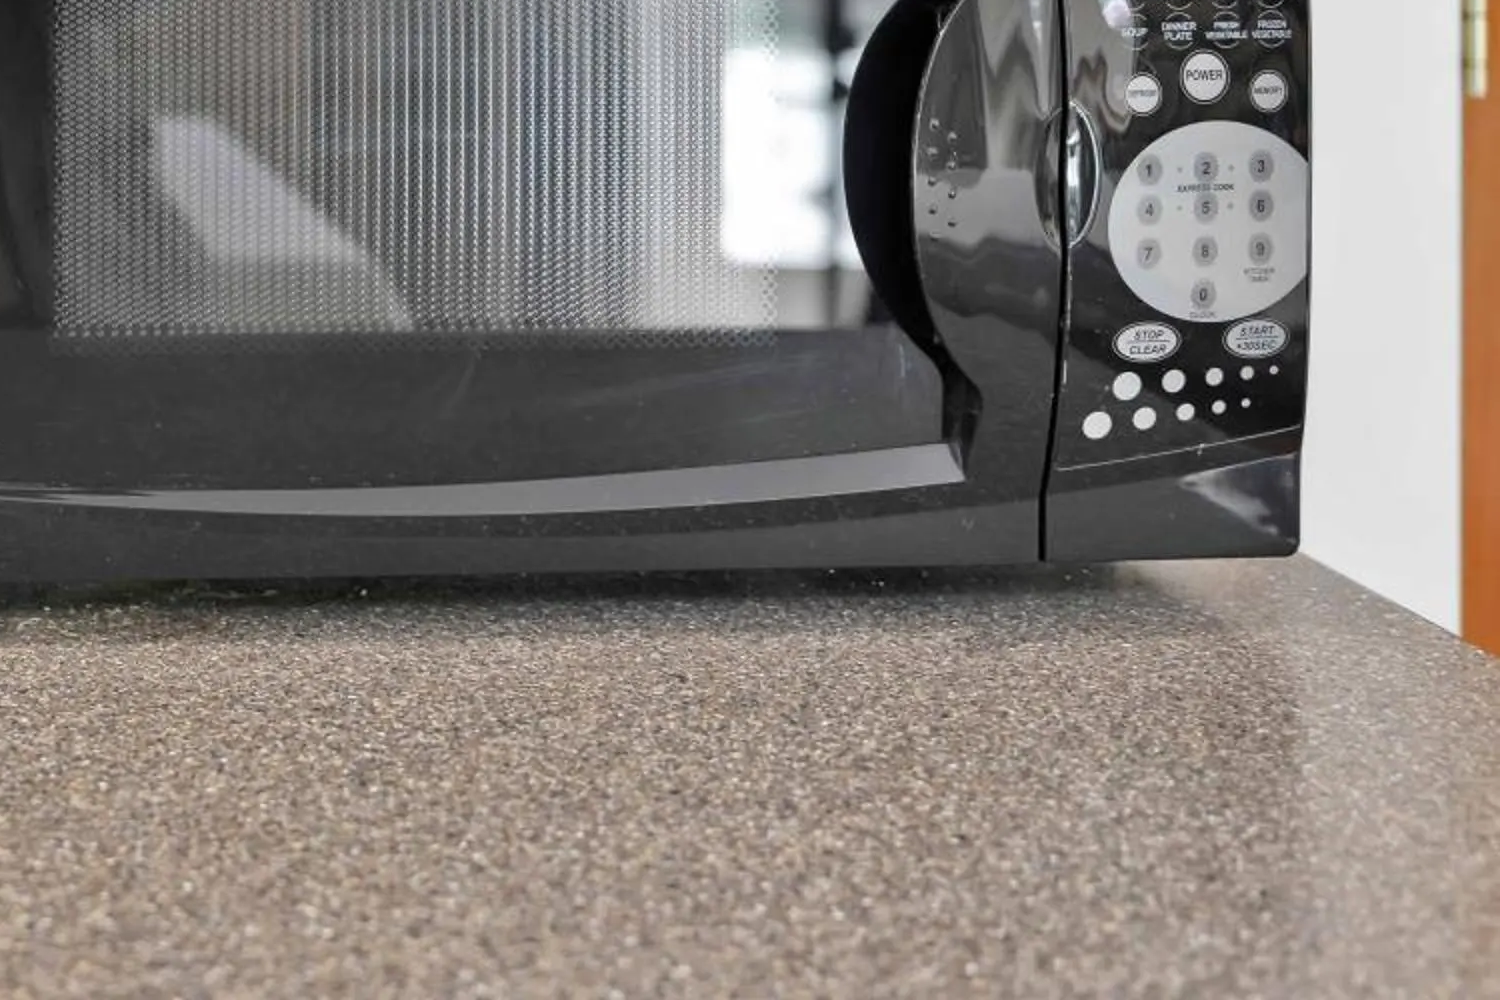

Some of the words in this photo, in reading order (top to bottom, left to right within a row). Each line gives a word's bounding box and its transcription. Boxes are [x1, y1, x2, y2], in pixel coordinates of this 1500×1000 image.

[1161, 21, 1197, 31] DINNER
[1164, 31, 1193, 41] PLATE
[1186, 69, 1223, 82] POWER
[1134, 329, 1164, 341] STOP
[1240, 325, 1275, 338] START
[1129, 344, 1166, 356] CLEAR
